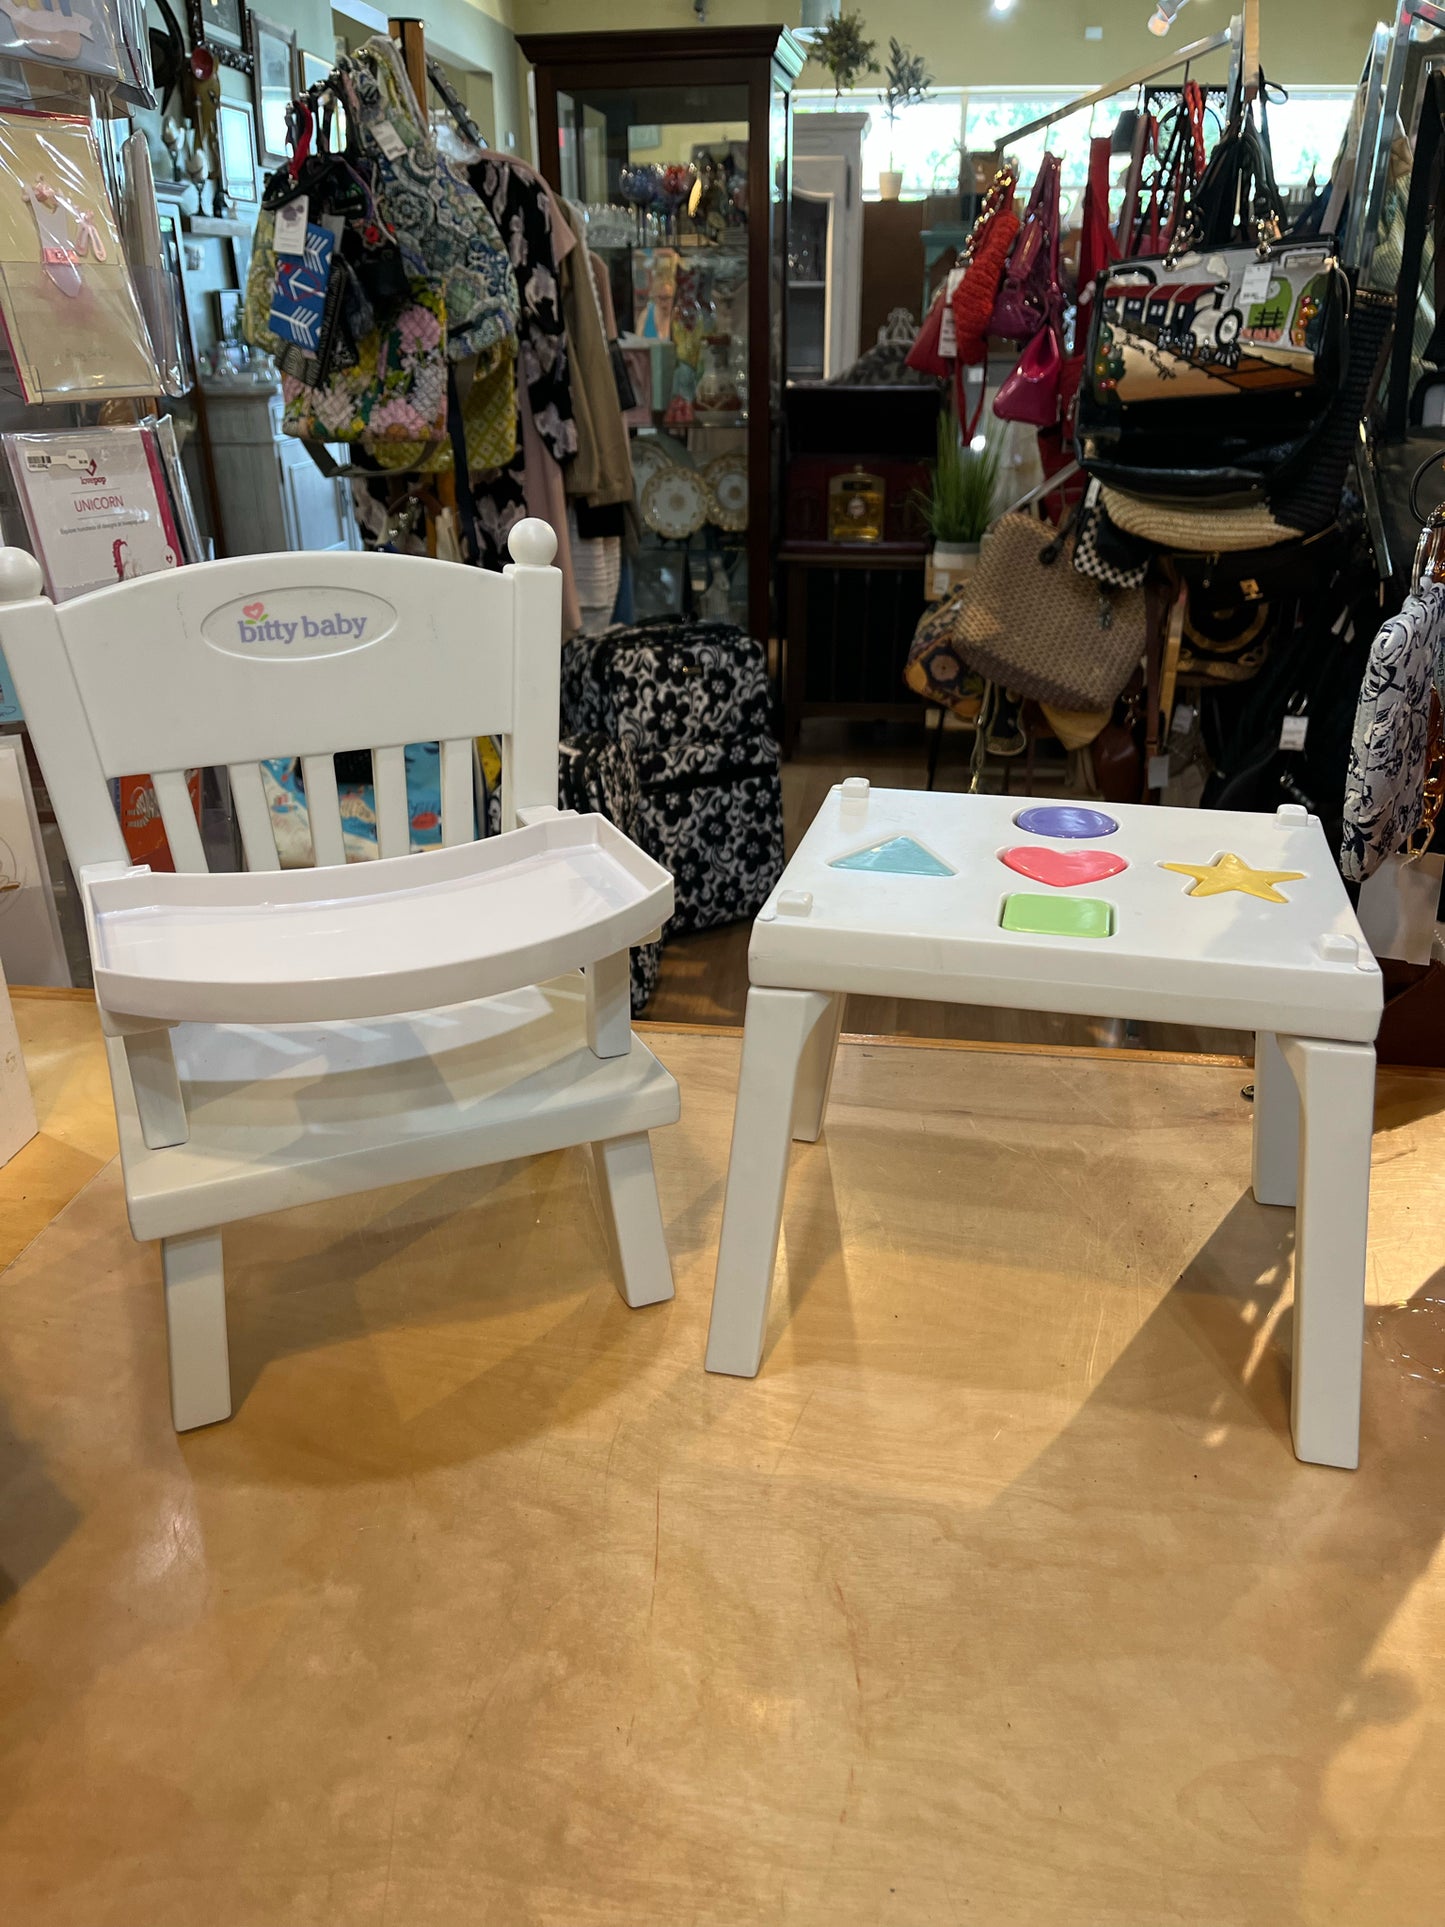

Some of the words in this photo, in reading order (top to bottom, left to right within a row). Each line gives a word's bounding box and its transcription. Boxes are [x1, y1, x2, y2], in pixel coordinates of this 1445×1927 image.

[74, 496, 124, 513] UNICORN
[238, 620, 298, 644] bitty
[301, 613, 367, 639] baby
